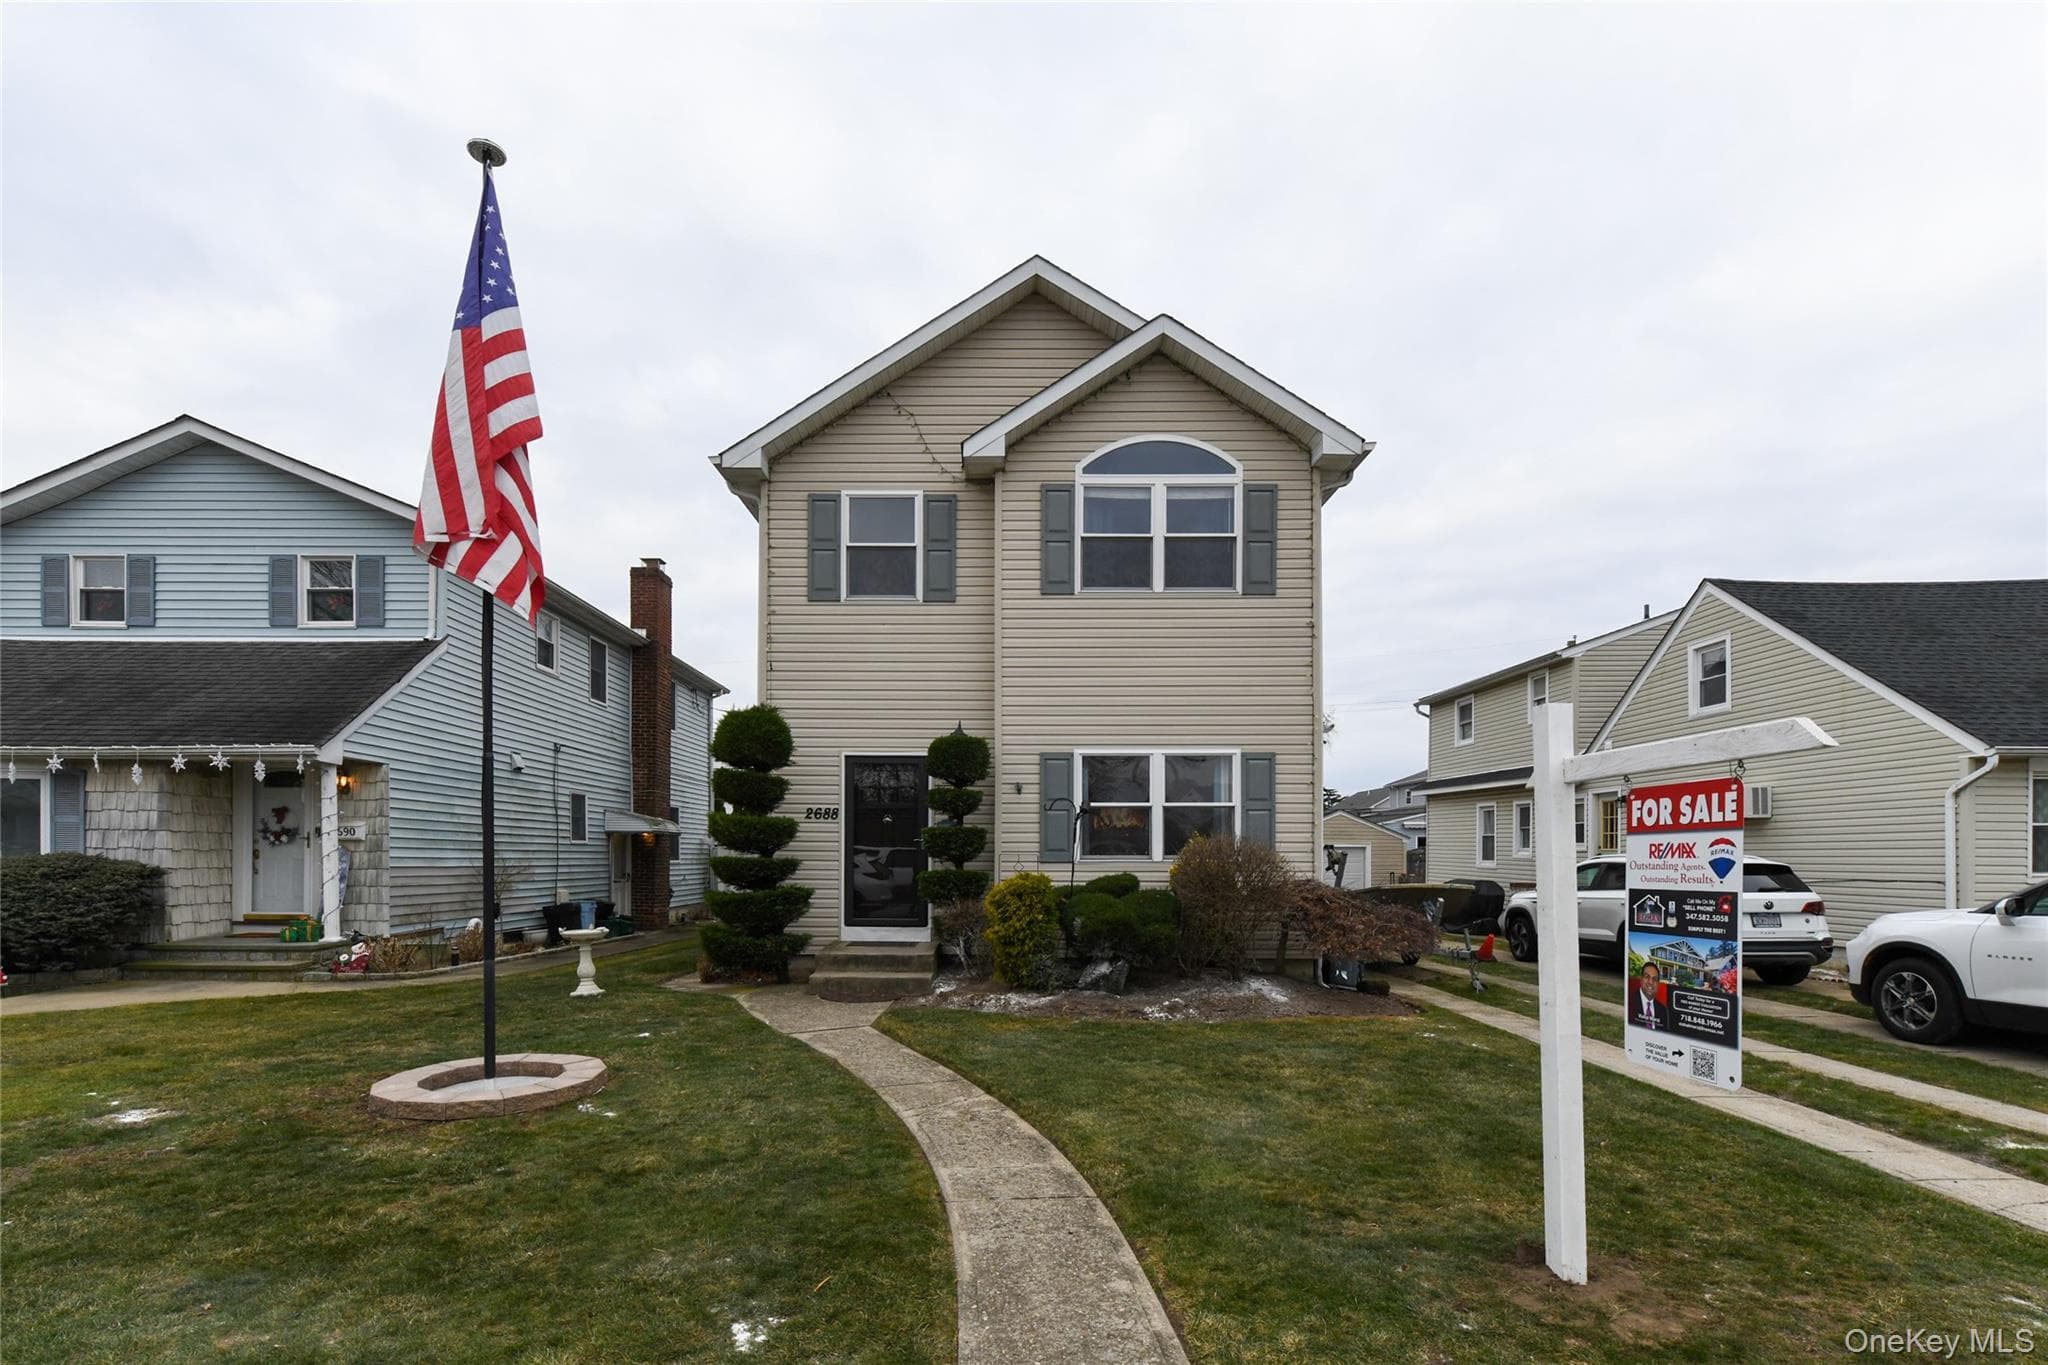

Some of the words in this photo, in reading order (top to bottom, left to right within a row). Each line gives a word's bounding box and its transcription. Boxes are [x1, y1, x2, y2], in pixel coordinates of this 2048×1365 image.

[805, 807, 839, 820] 2688
[1631, 797, 1673, 827] FOR
[1679, 791, 1738, 824] SALE
[1649, 842, 1697, 860] RE/MAX
[1710, 848, 1734, 856] RE/MAX
[1629, 860, 1679, 872] Outstanding
[1640, 874, 1678, 885] Outstanding
[1645, 1041, 1667, 1051] DISCOVER
[1645, 1047, 1653, 1055] THE
[1655, 1050, 1668, 1059] VALUE
[1665, 1060, 1678, 1068] HOME
